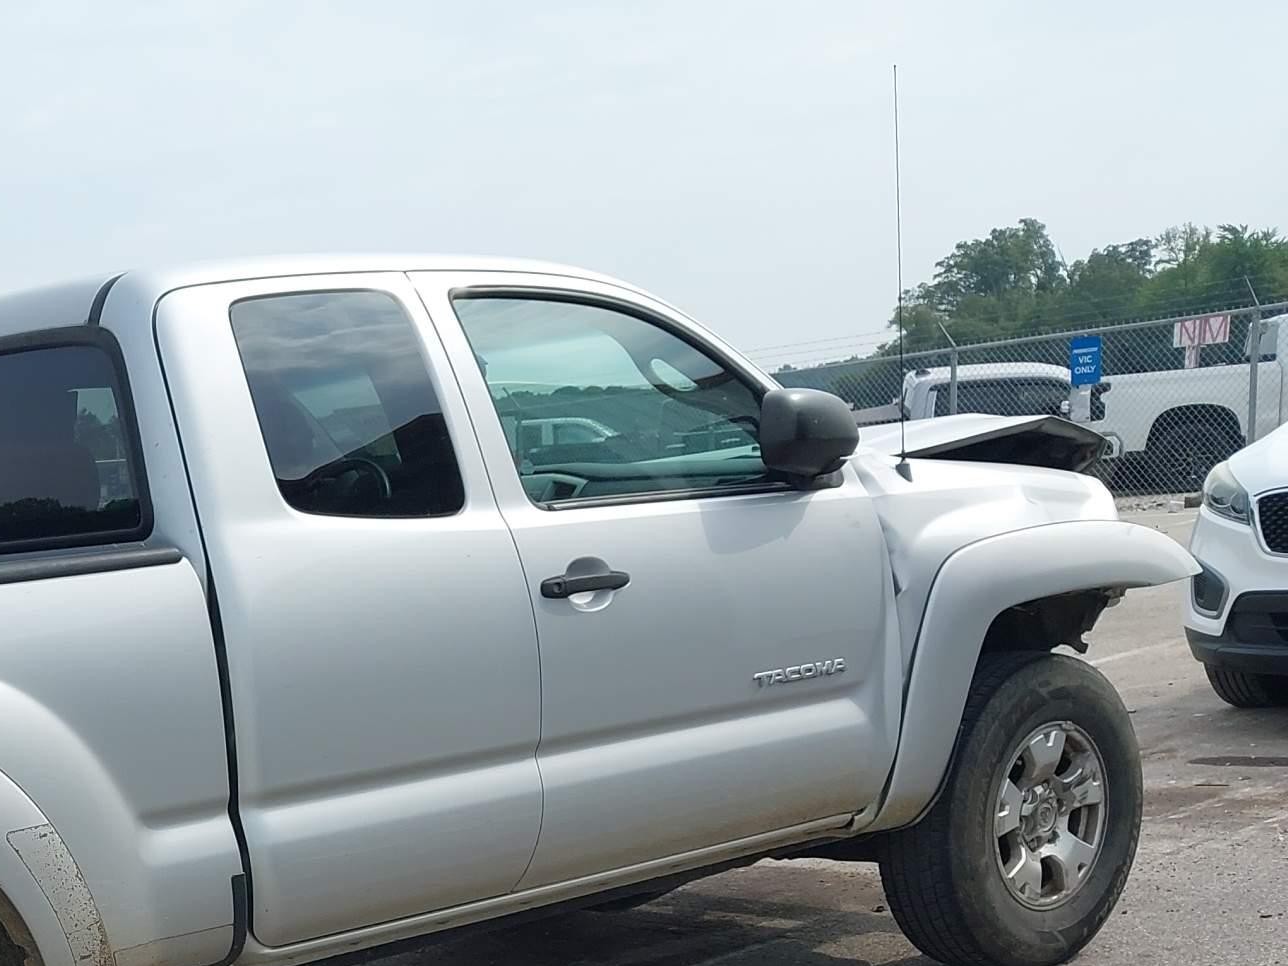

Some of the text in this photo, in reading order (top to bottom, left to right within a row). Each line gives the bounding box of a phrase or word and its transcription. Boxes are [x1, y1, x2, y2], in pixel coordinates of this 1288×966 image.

[1078, 355, 1093, 364] VIC
[1074, 365, 1096, 375] ONLY
[753, 657, 847, 688] TACOMA
